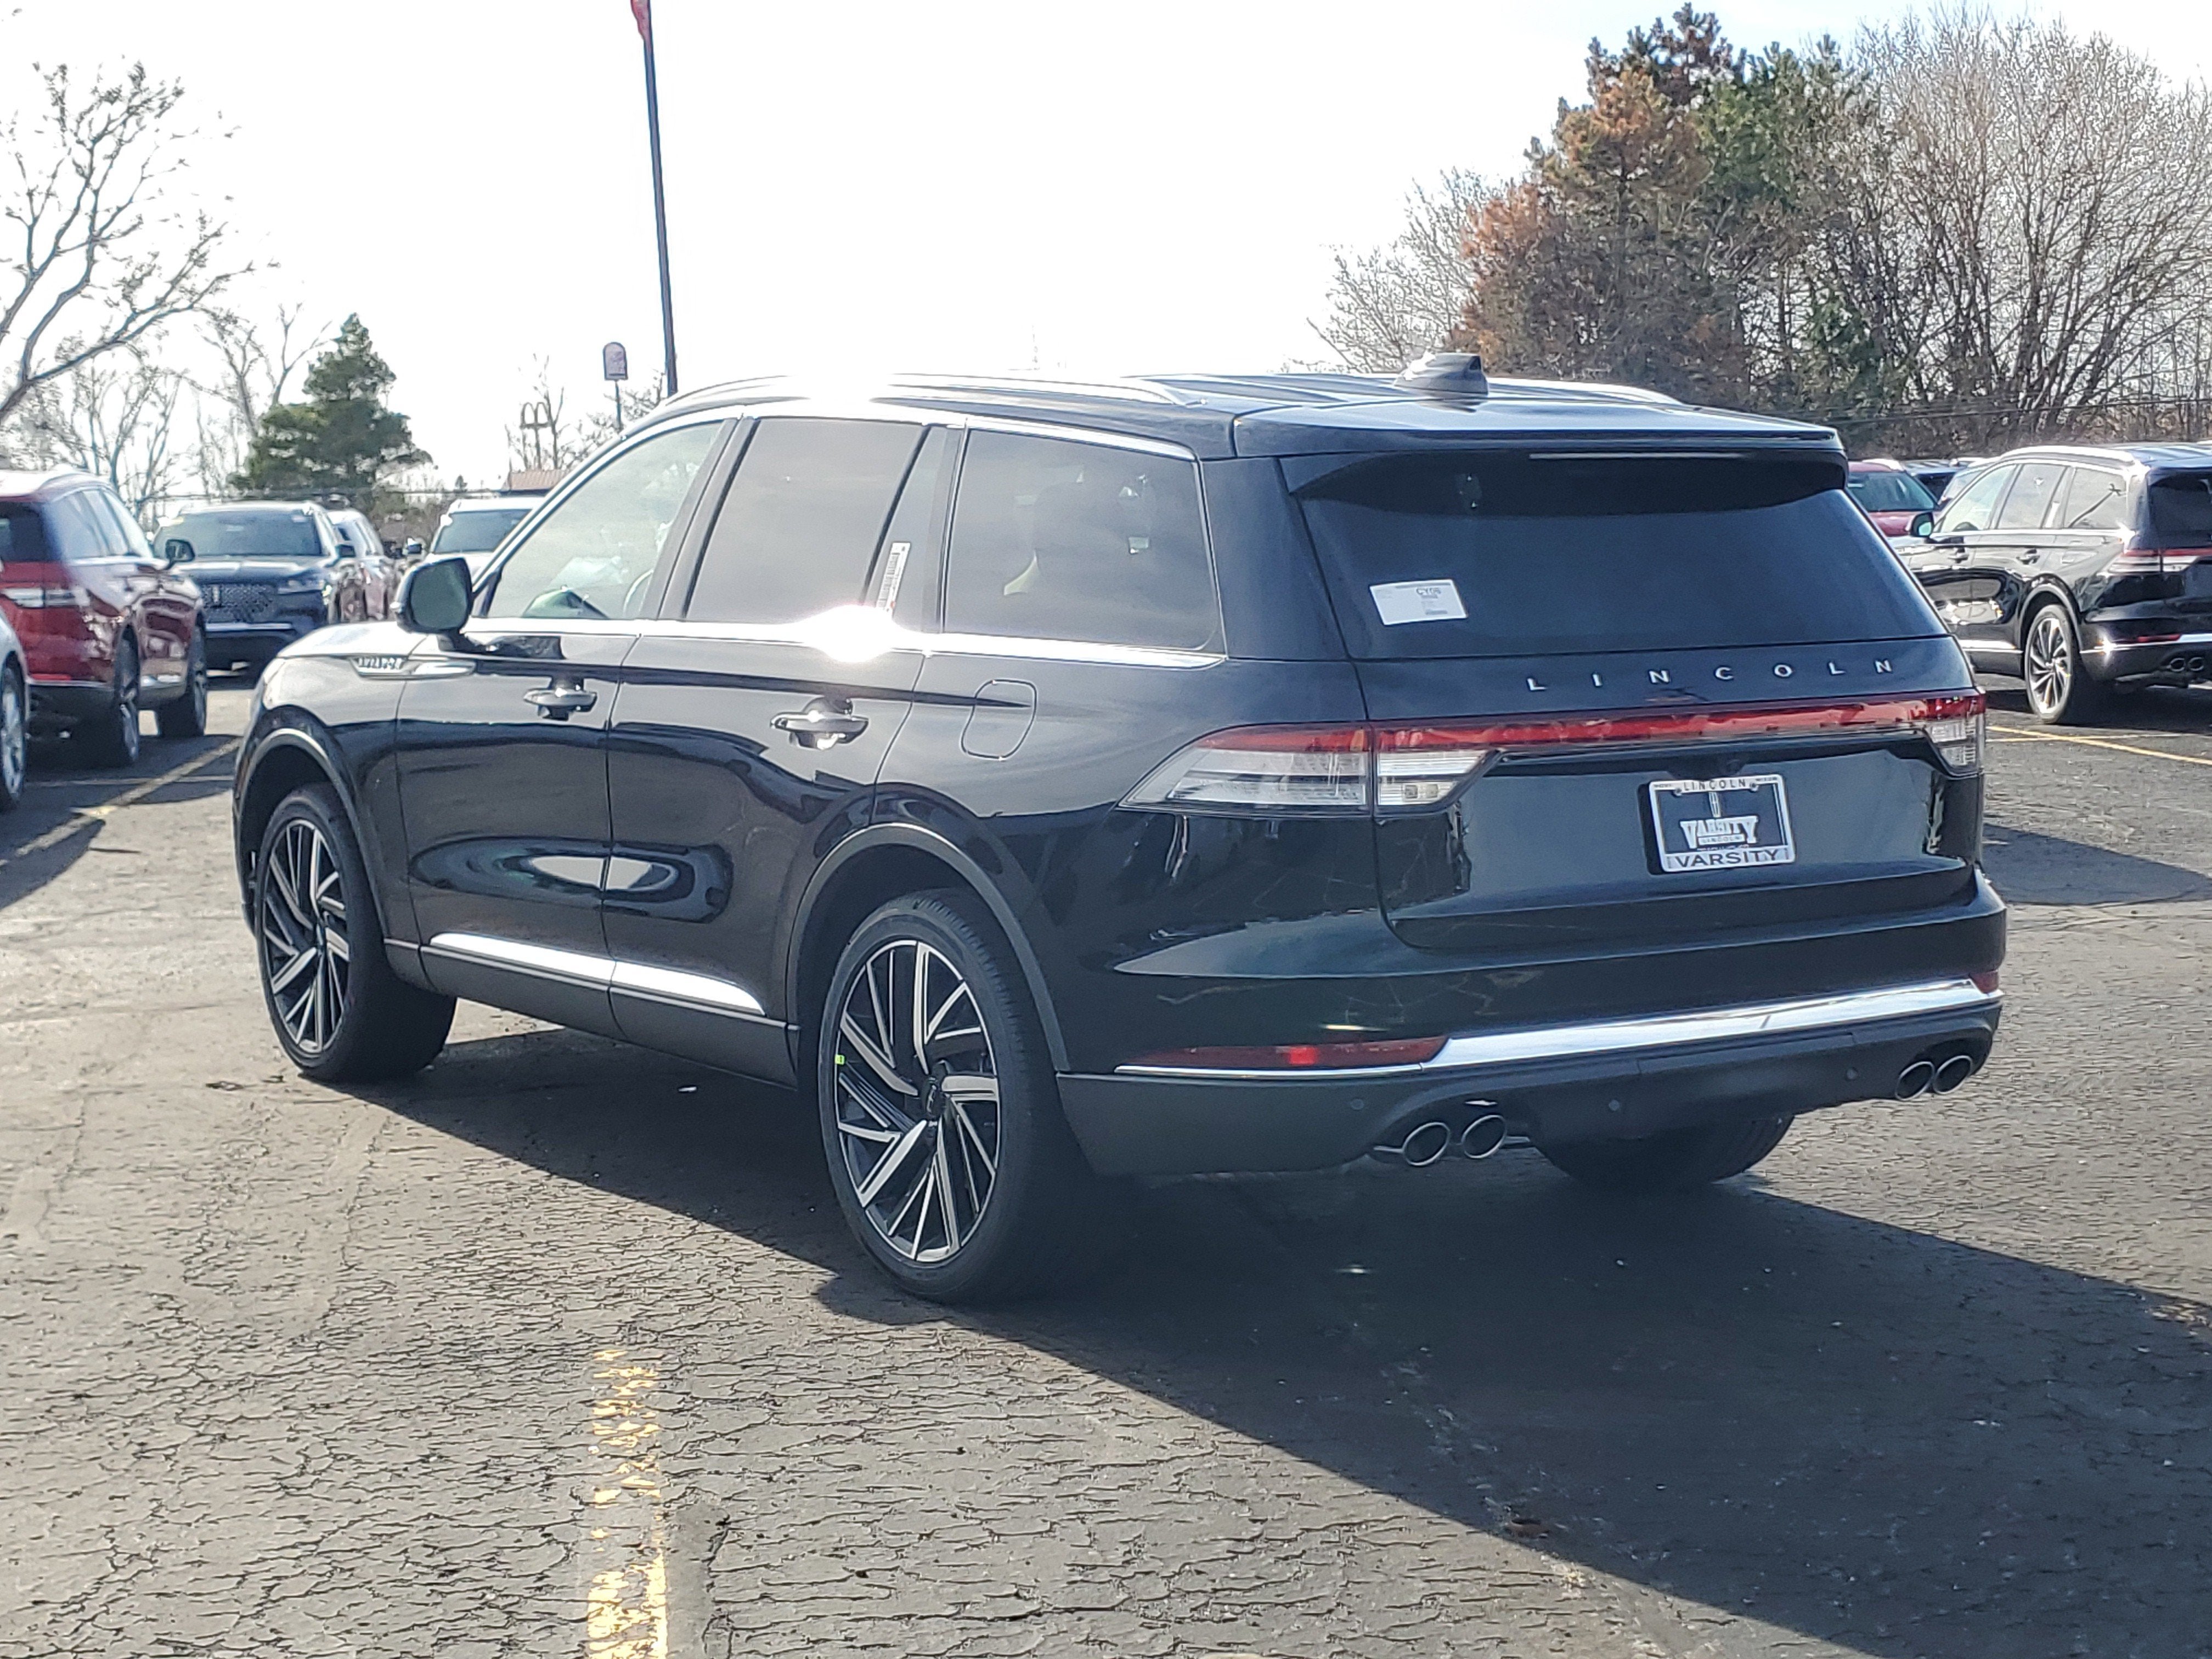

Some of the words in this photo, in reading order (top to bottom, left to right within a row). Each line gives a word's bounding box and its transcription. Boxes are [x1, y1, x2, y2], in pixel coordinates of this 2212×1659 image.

[1527, 659, 1893, 692] LINCOLN
[1684, 779, 1746, 791] LINCOLN
[1680, 816, 1759, 849] VARSITY
[1675, 850, 1779, 867] VARSITY
